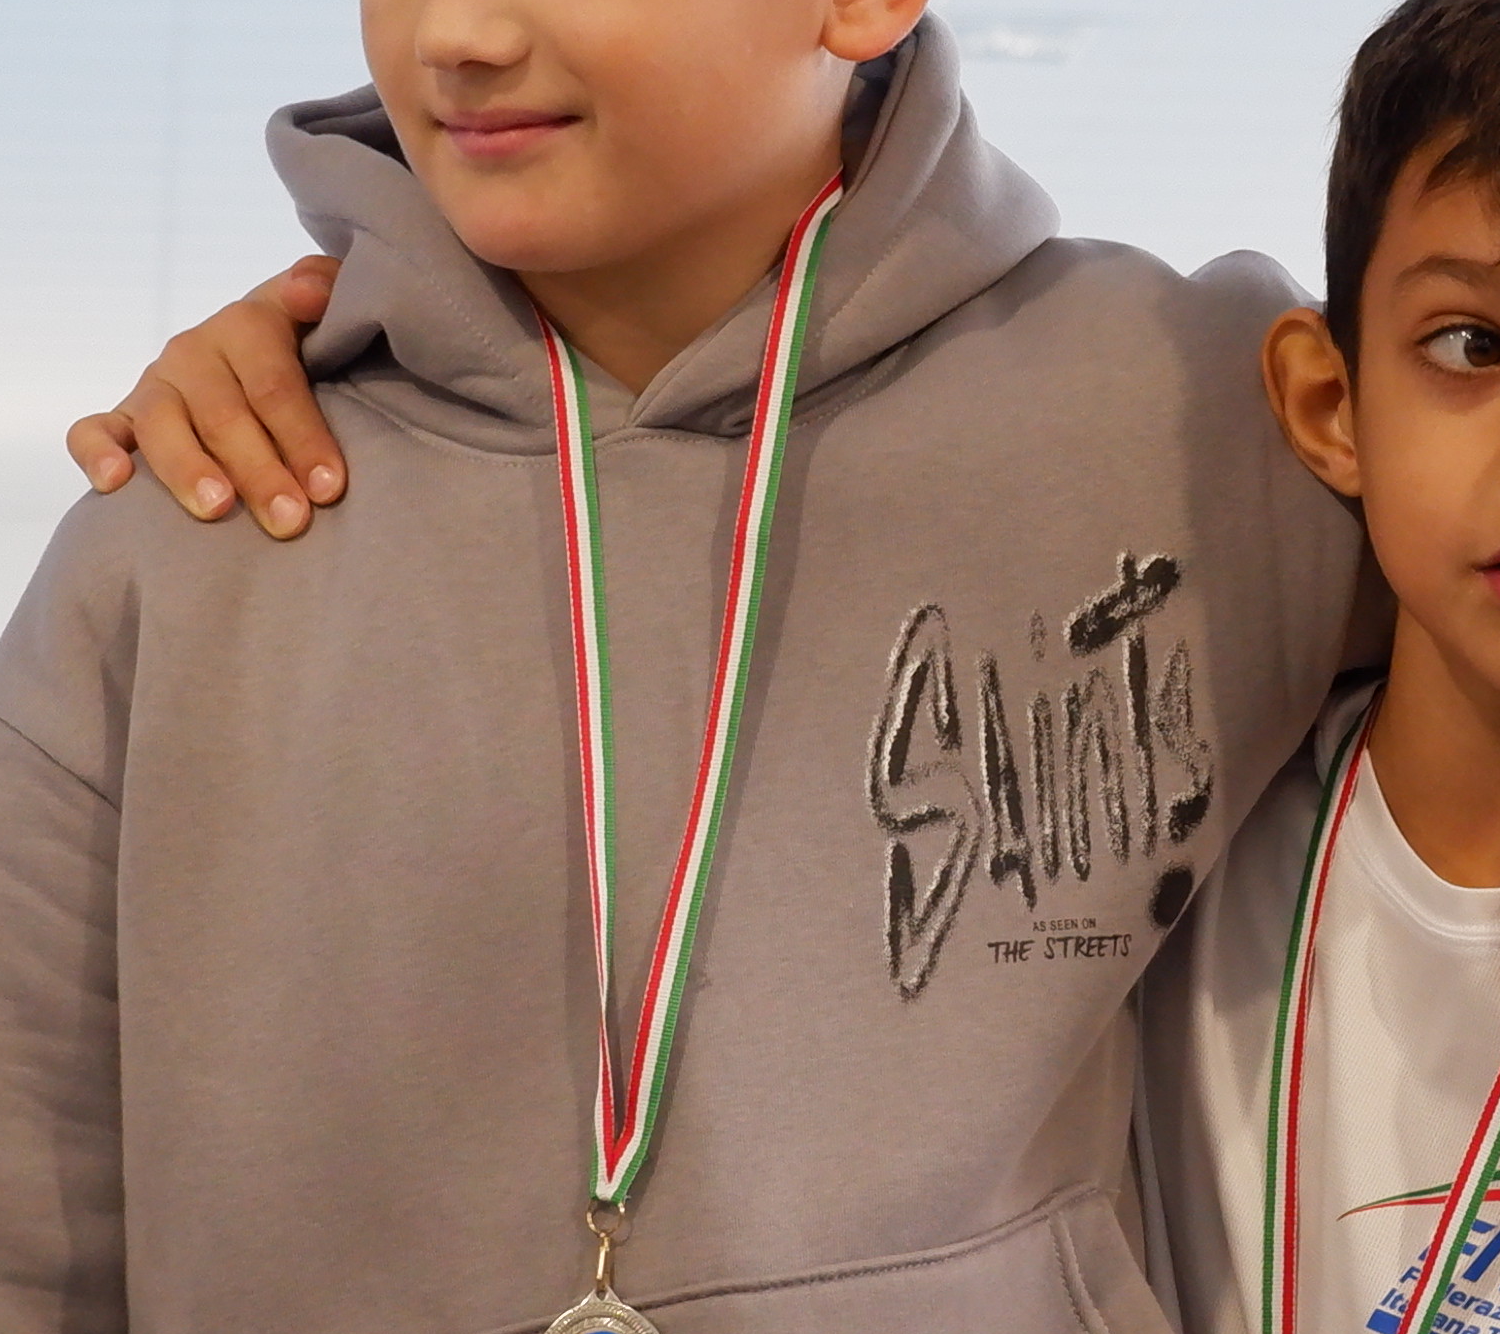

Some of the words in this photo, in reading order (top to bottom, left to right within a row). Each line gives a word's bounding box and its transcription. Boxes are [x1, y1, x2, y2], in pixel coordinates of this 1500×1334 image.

[1032, 920, 1047, 933] AS
[1050, 918, 1079, 931] SEEN
[1082, 917, 1097, 930] ON
[987, 939, 1036, 964] THE
[1043, 933, 1132, 960] STREETS
